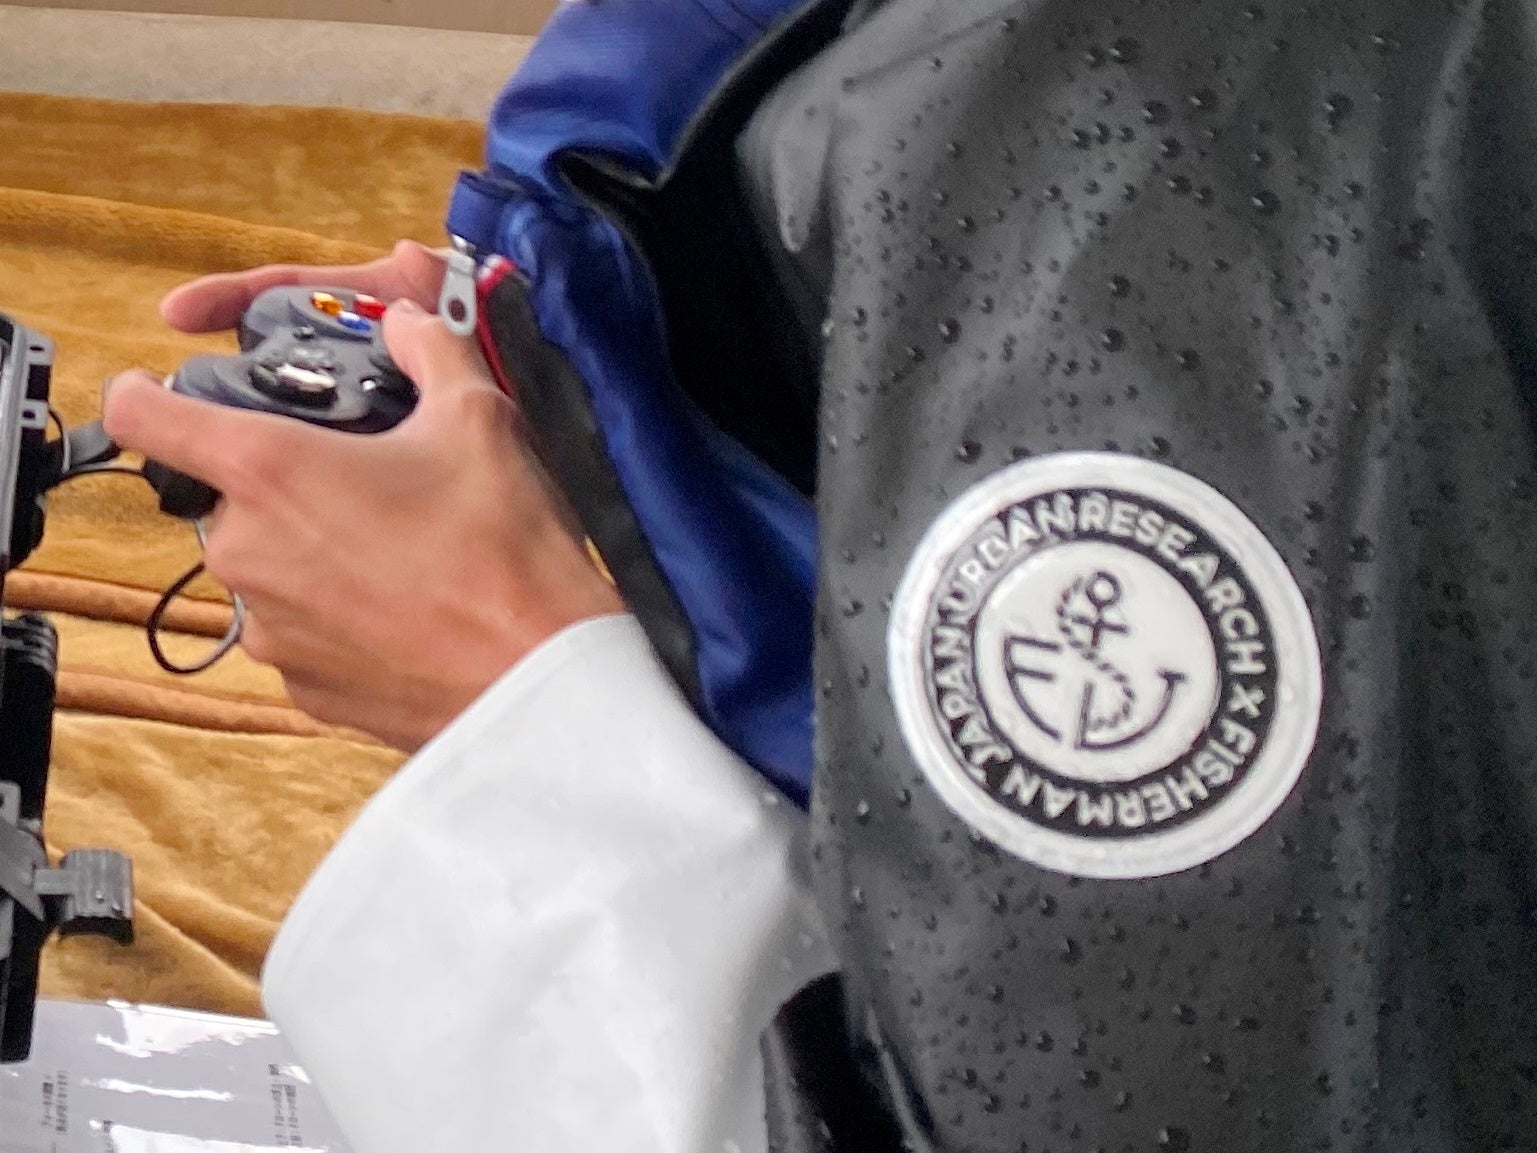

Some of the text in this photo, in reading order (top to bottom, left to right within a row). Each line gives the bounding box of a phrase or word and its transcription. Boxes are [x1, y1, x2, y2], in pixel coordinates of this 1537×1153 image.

[1077, 491, 1266, 675] RESEARCH
[932, 614, 1015, 785] JAPAN
[999, 716, 1258, 828] FISHERMAN
